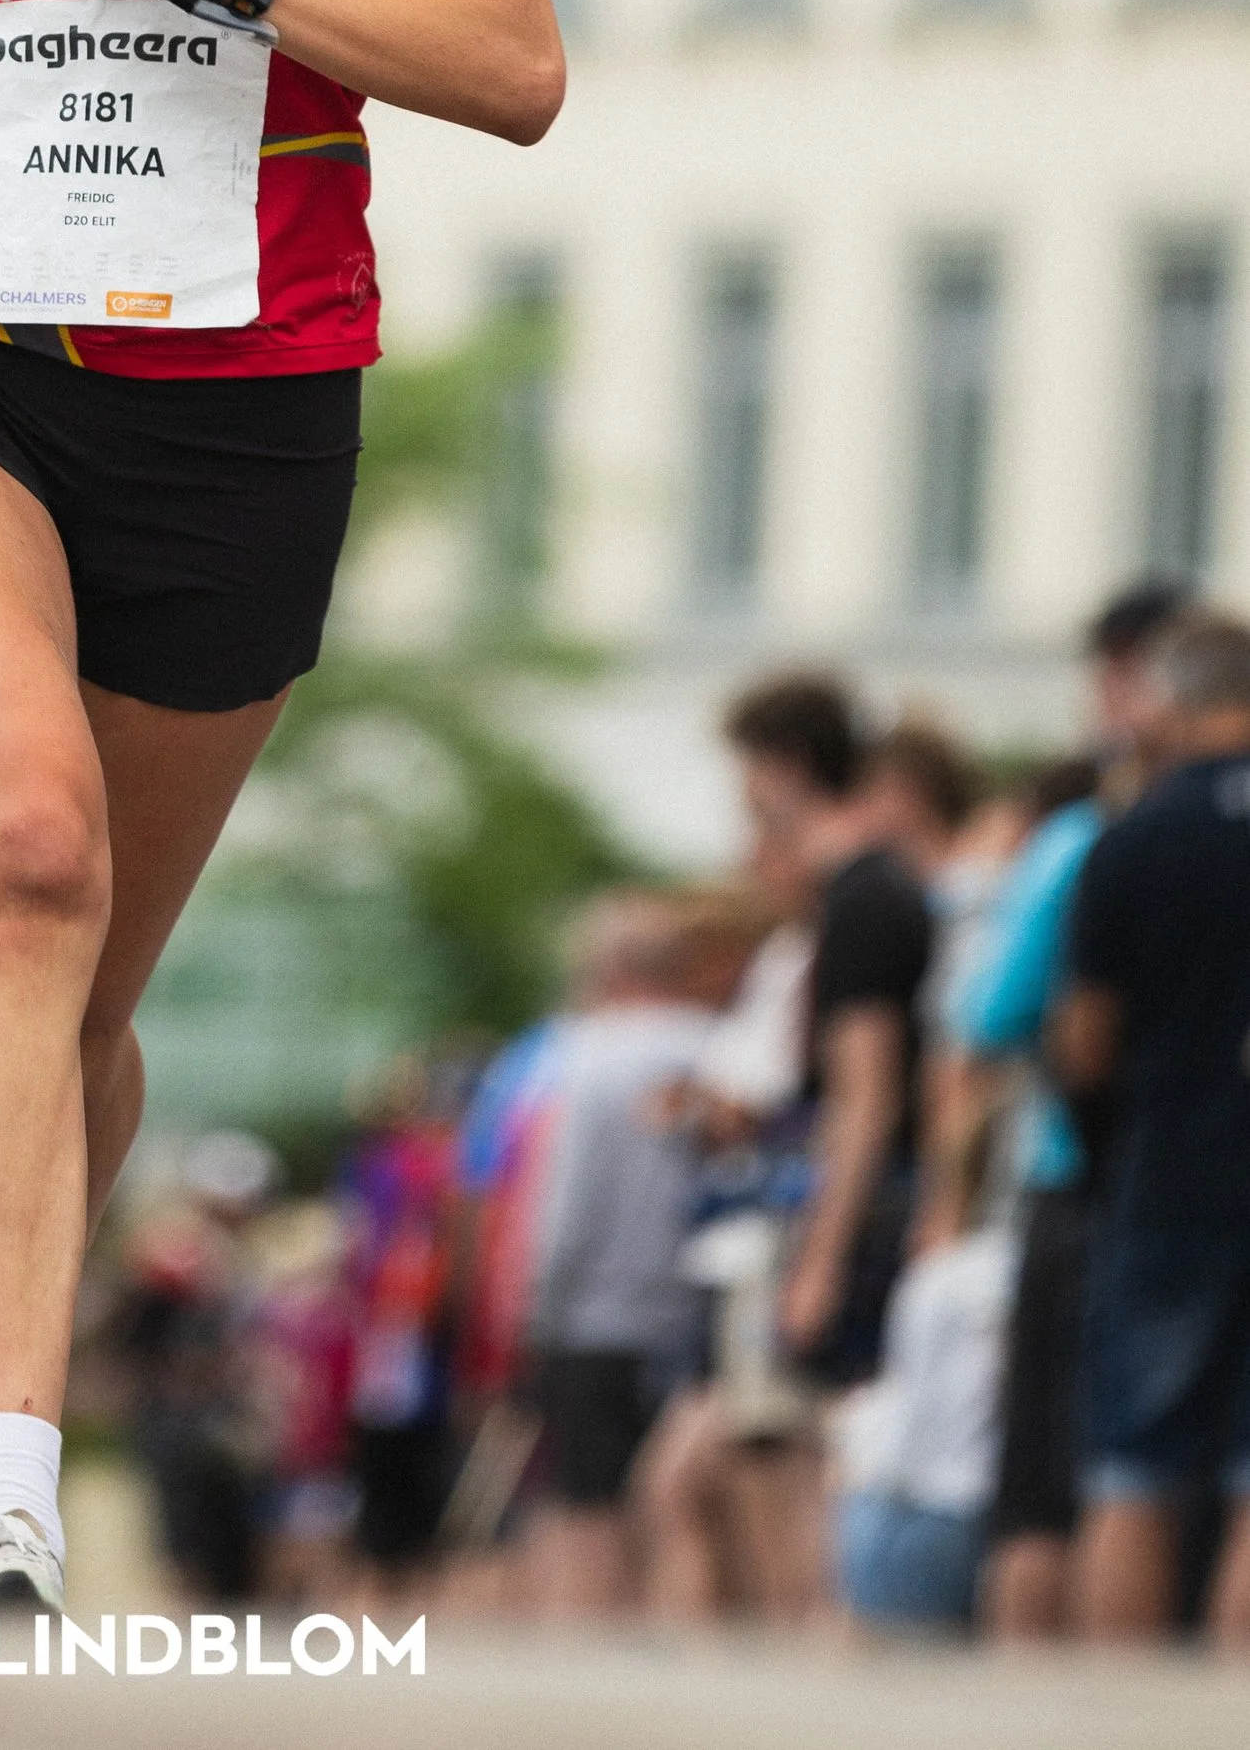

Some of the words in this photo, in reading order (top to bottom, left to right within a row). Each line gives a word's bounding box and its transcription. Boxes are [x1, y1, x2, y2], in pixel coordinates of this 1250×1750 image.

[59, 92, 133, 123] 8181
[23, 144, 166, 178] ANNIKA
[67, 192, 115, 204] FREIDIG
[64, 216, 88, 226] D20
[92, 216, 116, 227] ELIT
[0, 290, 87, 306] CHALMERS
